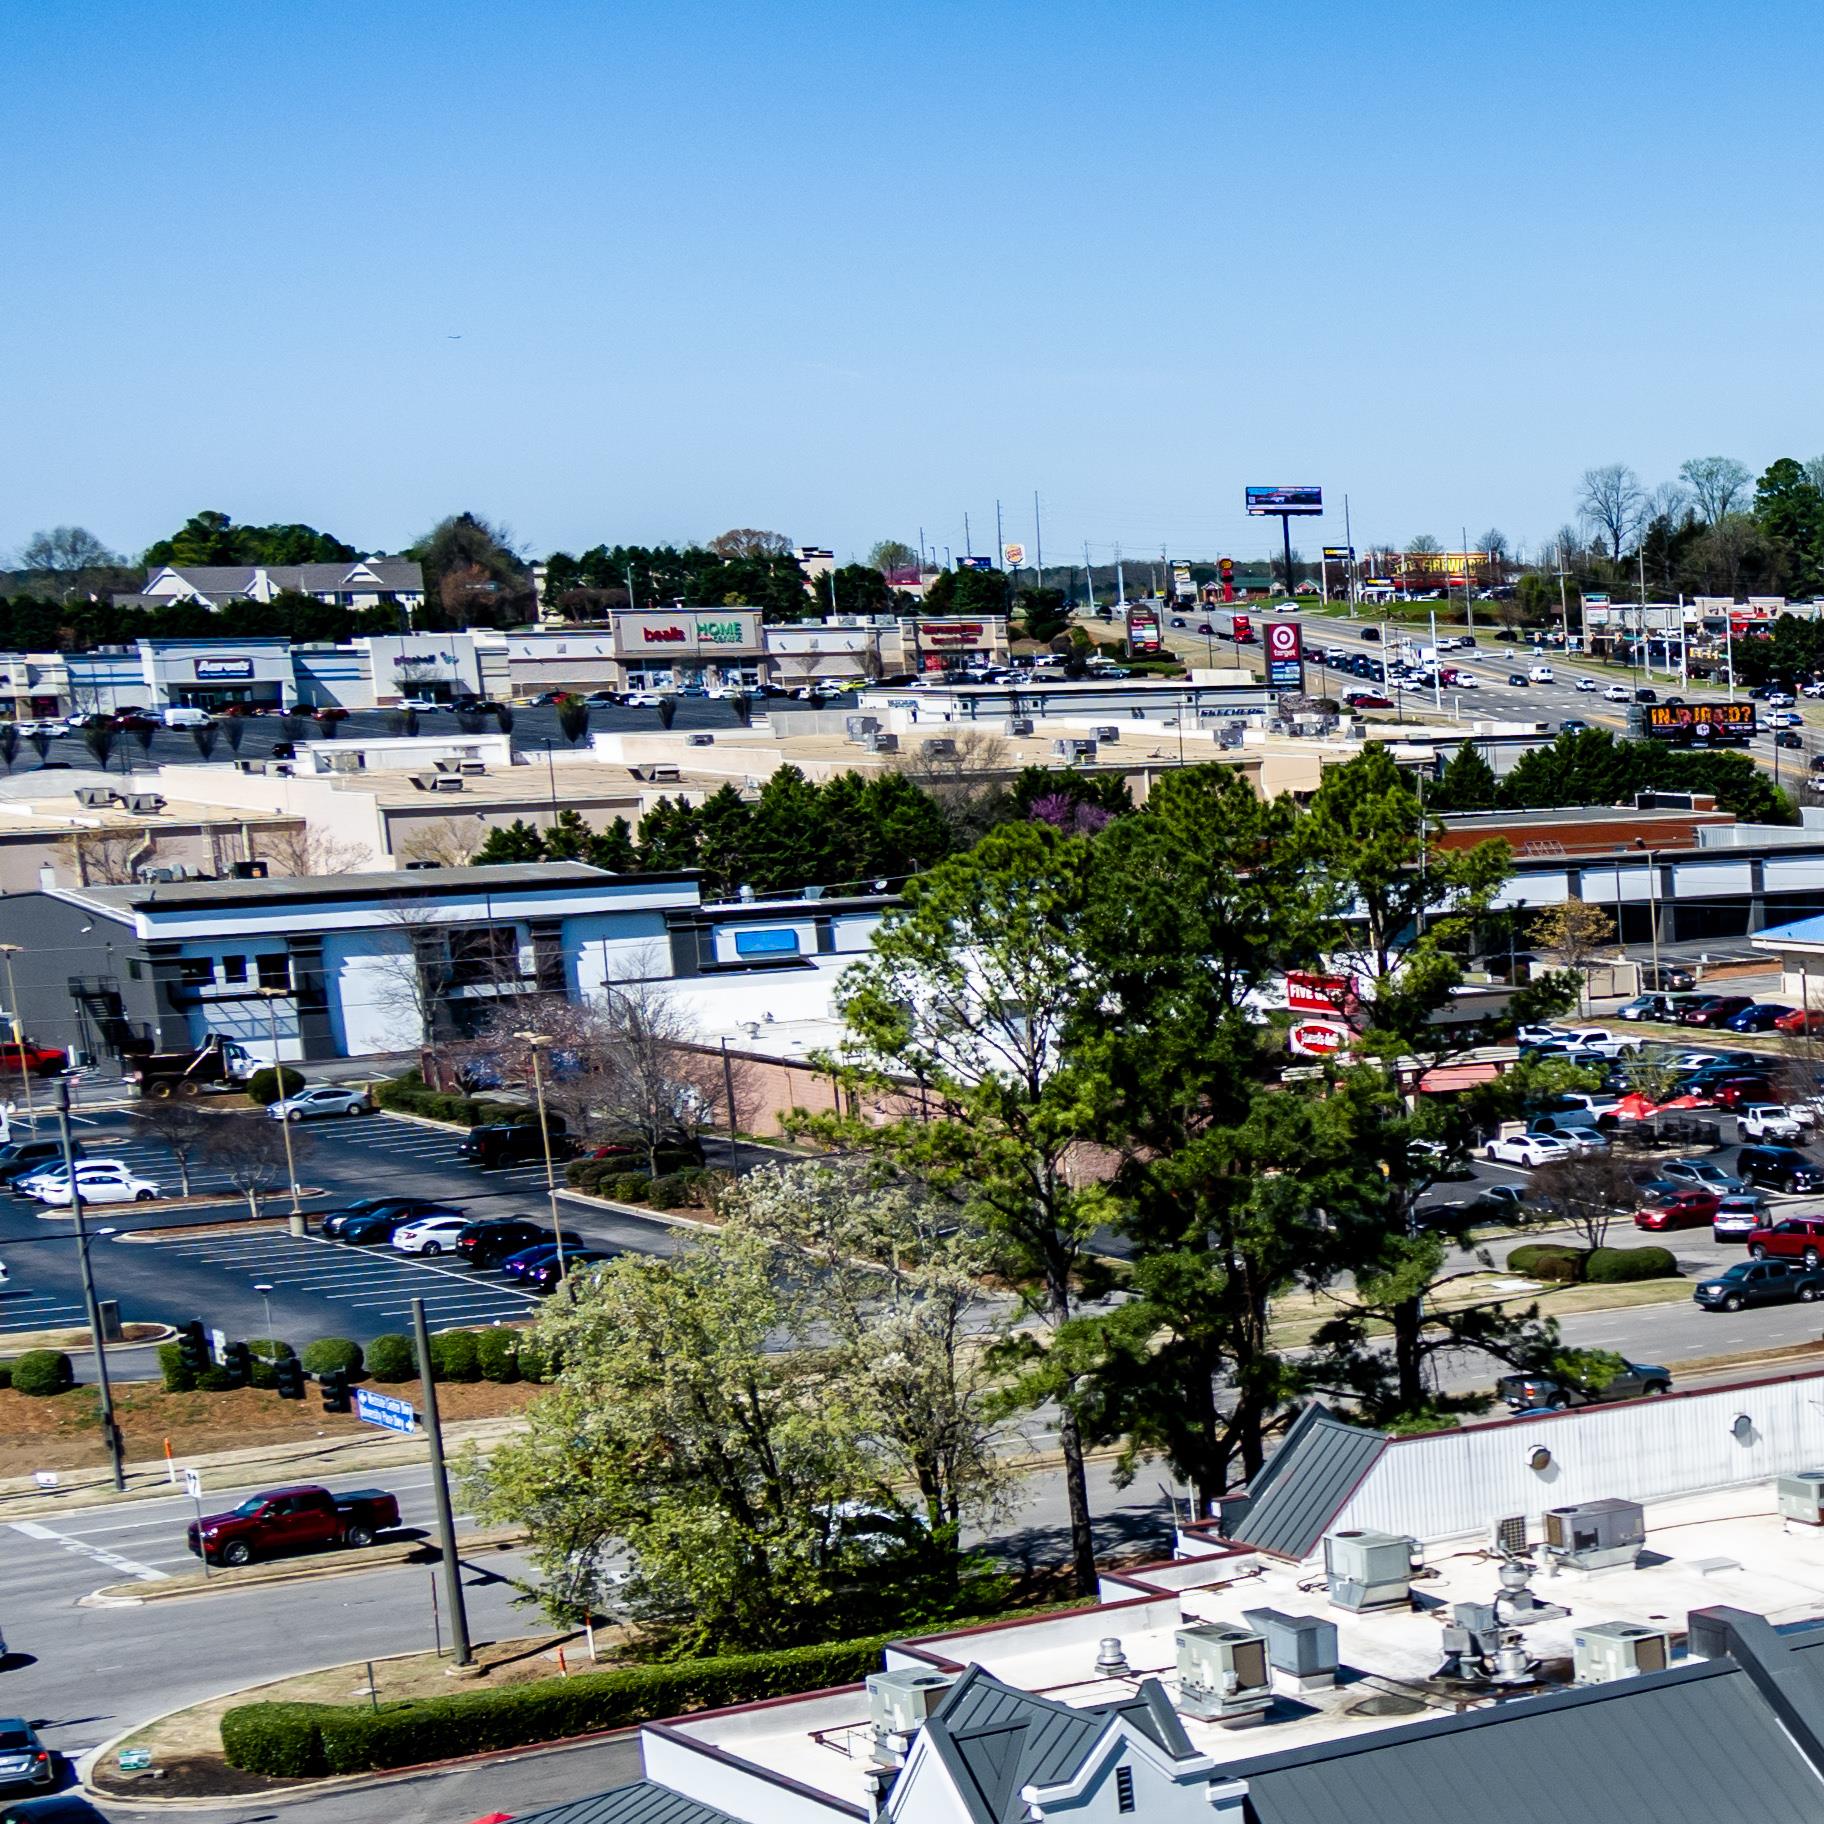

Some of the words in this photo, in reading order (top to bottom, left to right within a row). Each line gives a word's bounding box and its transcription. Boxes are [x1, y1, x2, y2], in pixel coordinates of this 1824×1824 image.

[696, 622, 743, 637] HOME
[1273, 649, 1296, 658] target
[1290, 984, 1314, 1000] FIVE
